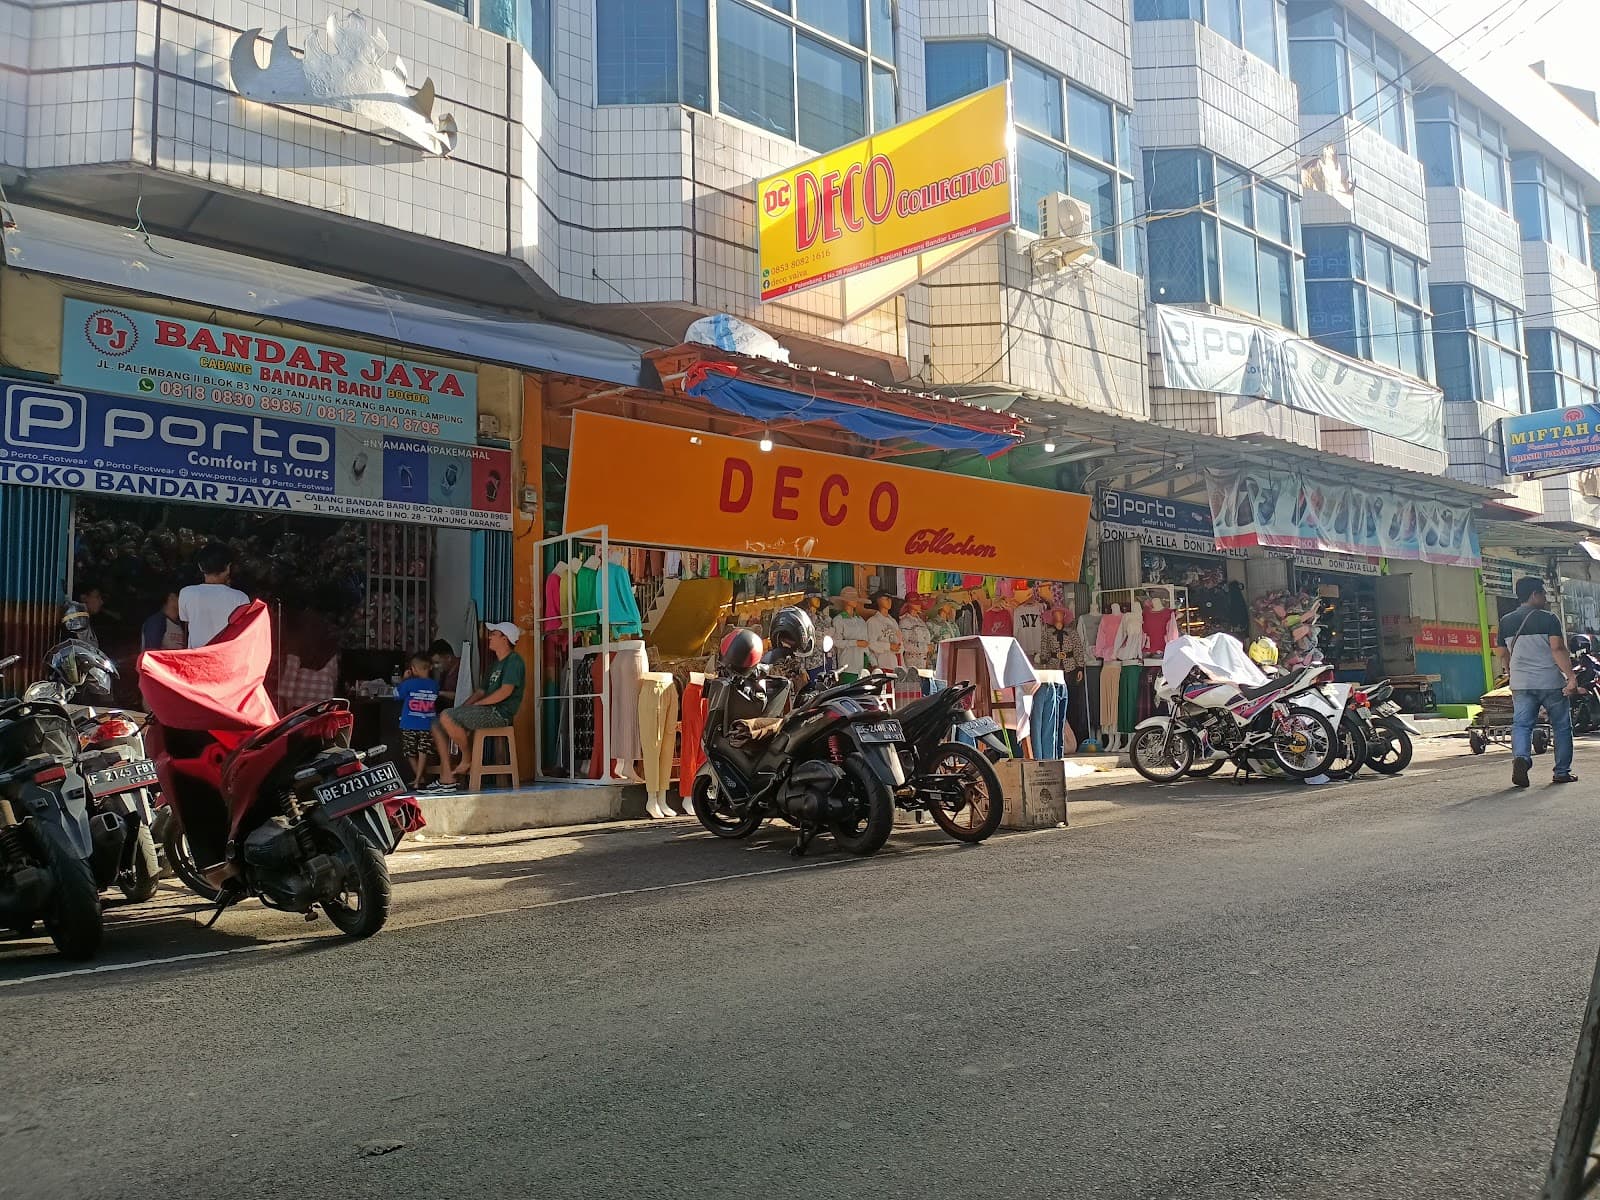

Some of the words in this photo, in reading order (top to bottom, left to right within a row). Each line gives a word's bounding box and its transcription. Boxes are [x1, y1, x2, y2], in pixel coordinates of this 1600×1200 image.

[764, 183, 791, 211] DC
[896, 158, 1007, 218] COLLECTION
[795, 153, 895, 252] DECO
[154, 320, 348, 376] BANDAR
[360, 360, 465, 396] JAYA
[96, 360, 114, 370] JL.
[118, 362, 190, 382] PALEMBANG
[193, 374, 200, 383] II
[203, 376, 232, 388] BLOK
[236, 381, 250, 391] B3
[286, 390, 332, 404] TANJUNG
[335, 398, 376, 411] KARANG
[378, 404, 416, 417] BANDAR
[420, 412, 464, 424] LAMPUNG
[200, 357, 252, 374] CABANG
[259, 366, 332, 392] BANDAR
[337, 380, 382, 400] BARU
[386, 389, 430, 404] BOGOR
[160, 381, 206, 400] 0818
[210, 389, 255, 408] 0830
[260, 396, 302, 415] 8985
[306, 404, 312, 417] /
[316, 405, 356, 424] 0812
[361, 410, 399, 429] 7914
[403, 417, 440, 435] 8795
[18, 396, 74, 438] P
[104, 408, 330, 462] porto
[1510, 422, 1590, 445] MIFTAH
[363, 439, 491, 460] #NYAMANGAKPAKEMAHAL
[106, 461, 132, 471] Porto
[134, 464, 175, 475] Footwear
[190, 470, 258, 484] www.porto.co.id
[188, 450, 257, 472] Comfort
[264, 460, 278, 474] Is
[284, 462, 330, 480] Yours
[0, 462, 86, 488] TOKO
[95, 472, 218, 502] BANDAR
[226, 486, 292, 509] JAYA
[719, 457, 900, 532] DECO
[304, 494, 344, 504] CABANG
[346, 498, 384, 508] BANDAR
[386, 502, 411, 511] BARU
[412, 504, 444, 514] BOGOR
[328, 505, 385, 518] PALEMBANG
[411, 513, 422, 521] 28
[429, 514, 468, 525] TANJUNG
[468, 518, 501, 528] KARANG
[1123, 500, 1176, 518] porto
[904, 528, 997, 558] Collection
[1156, 536, 1178, 548] ELLA
[1184, 540, 1204, 552] DONI
[1207, 542, 1227, 554] JAA
[1306, 557, 1322, 566] ELLA
[1328, 560, 1345, 569] DONI
[1346, 562, 1362, 571] JAYA
[1362, 563, 1378, 573] ELLA
[1020, 614, 1038, 628] NY
[105, 767, 132, 782] 2145
[136, 762, 155, 776] FBY
[322, 785, 342, 802] BE
[340, 775, 370, 796] 2731
